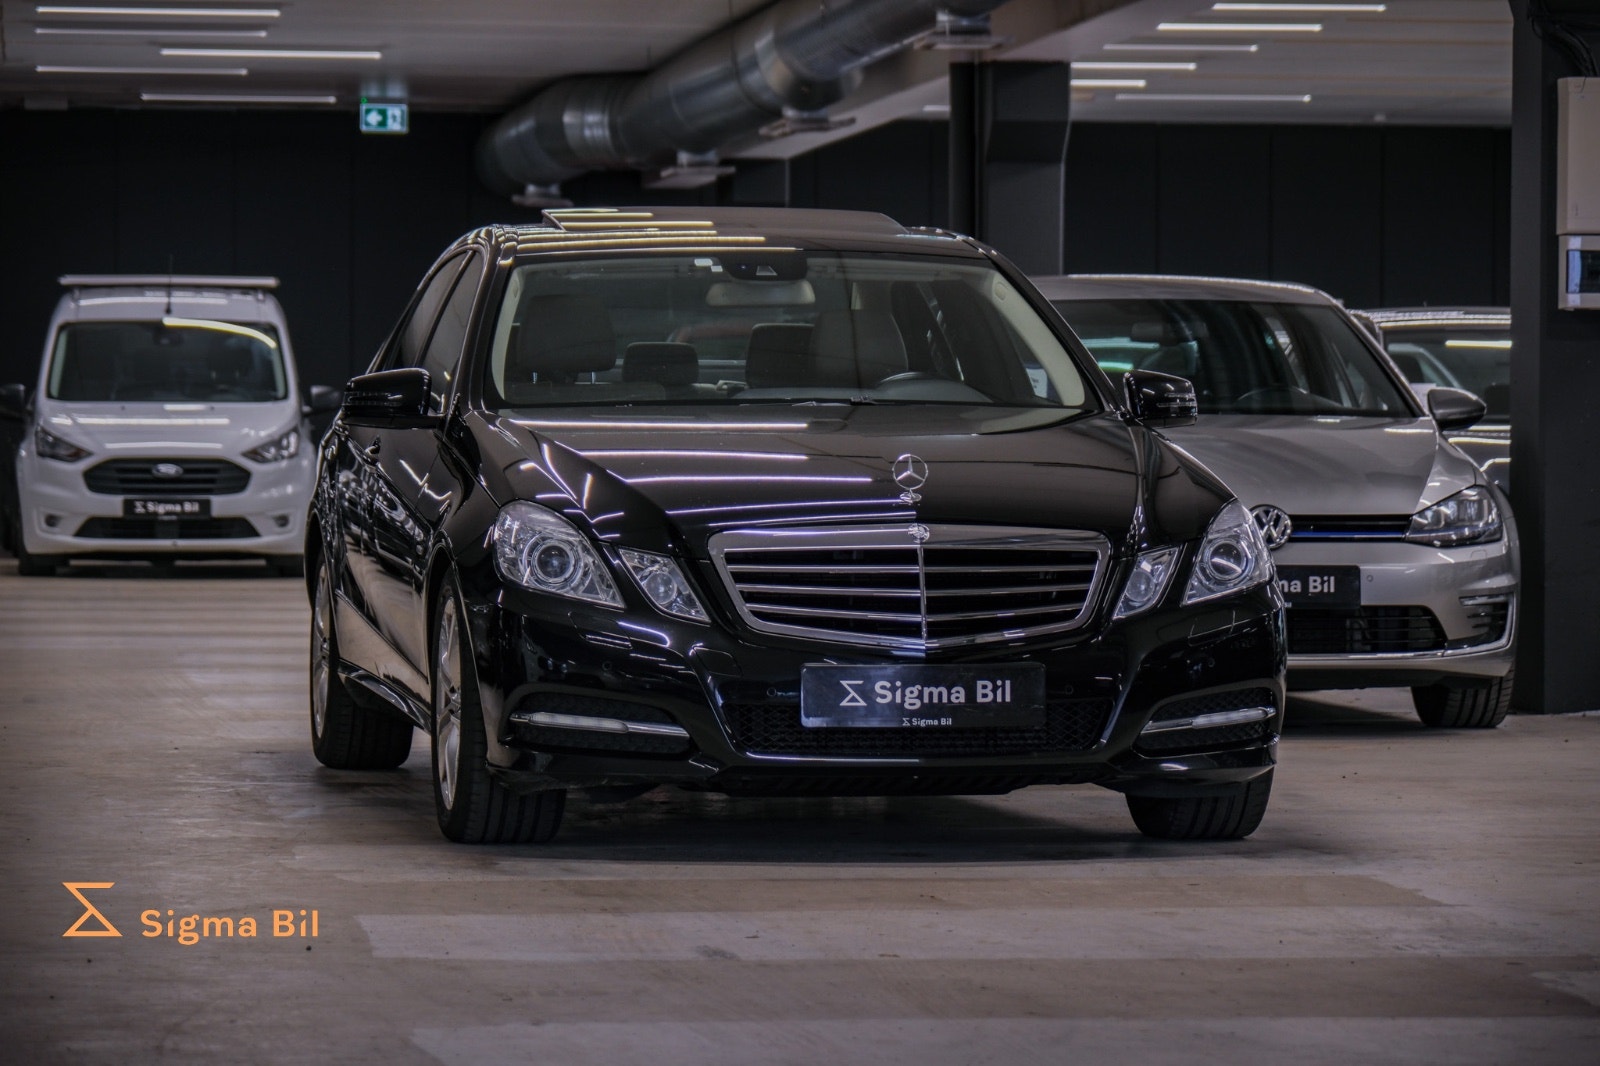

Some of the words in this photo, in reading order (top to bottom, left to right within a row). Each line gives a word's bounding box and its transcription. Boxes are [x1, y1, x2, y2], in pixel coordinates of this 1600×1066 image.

[1308, 575, 1335, 593] Bil
[874, 680, 966, 710] Sigma
[976, 680, 1011, 703] Bil
[911, 717, 939, 727] Sigma
[940, 717, 952, 726] Bil
